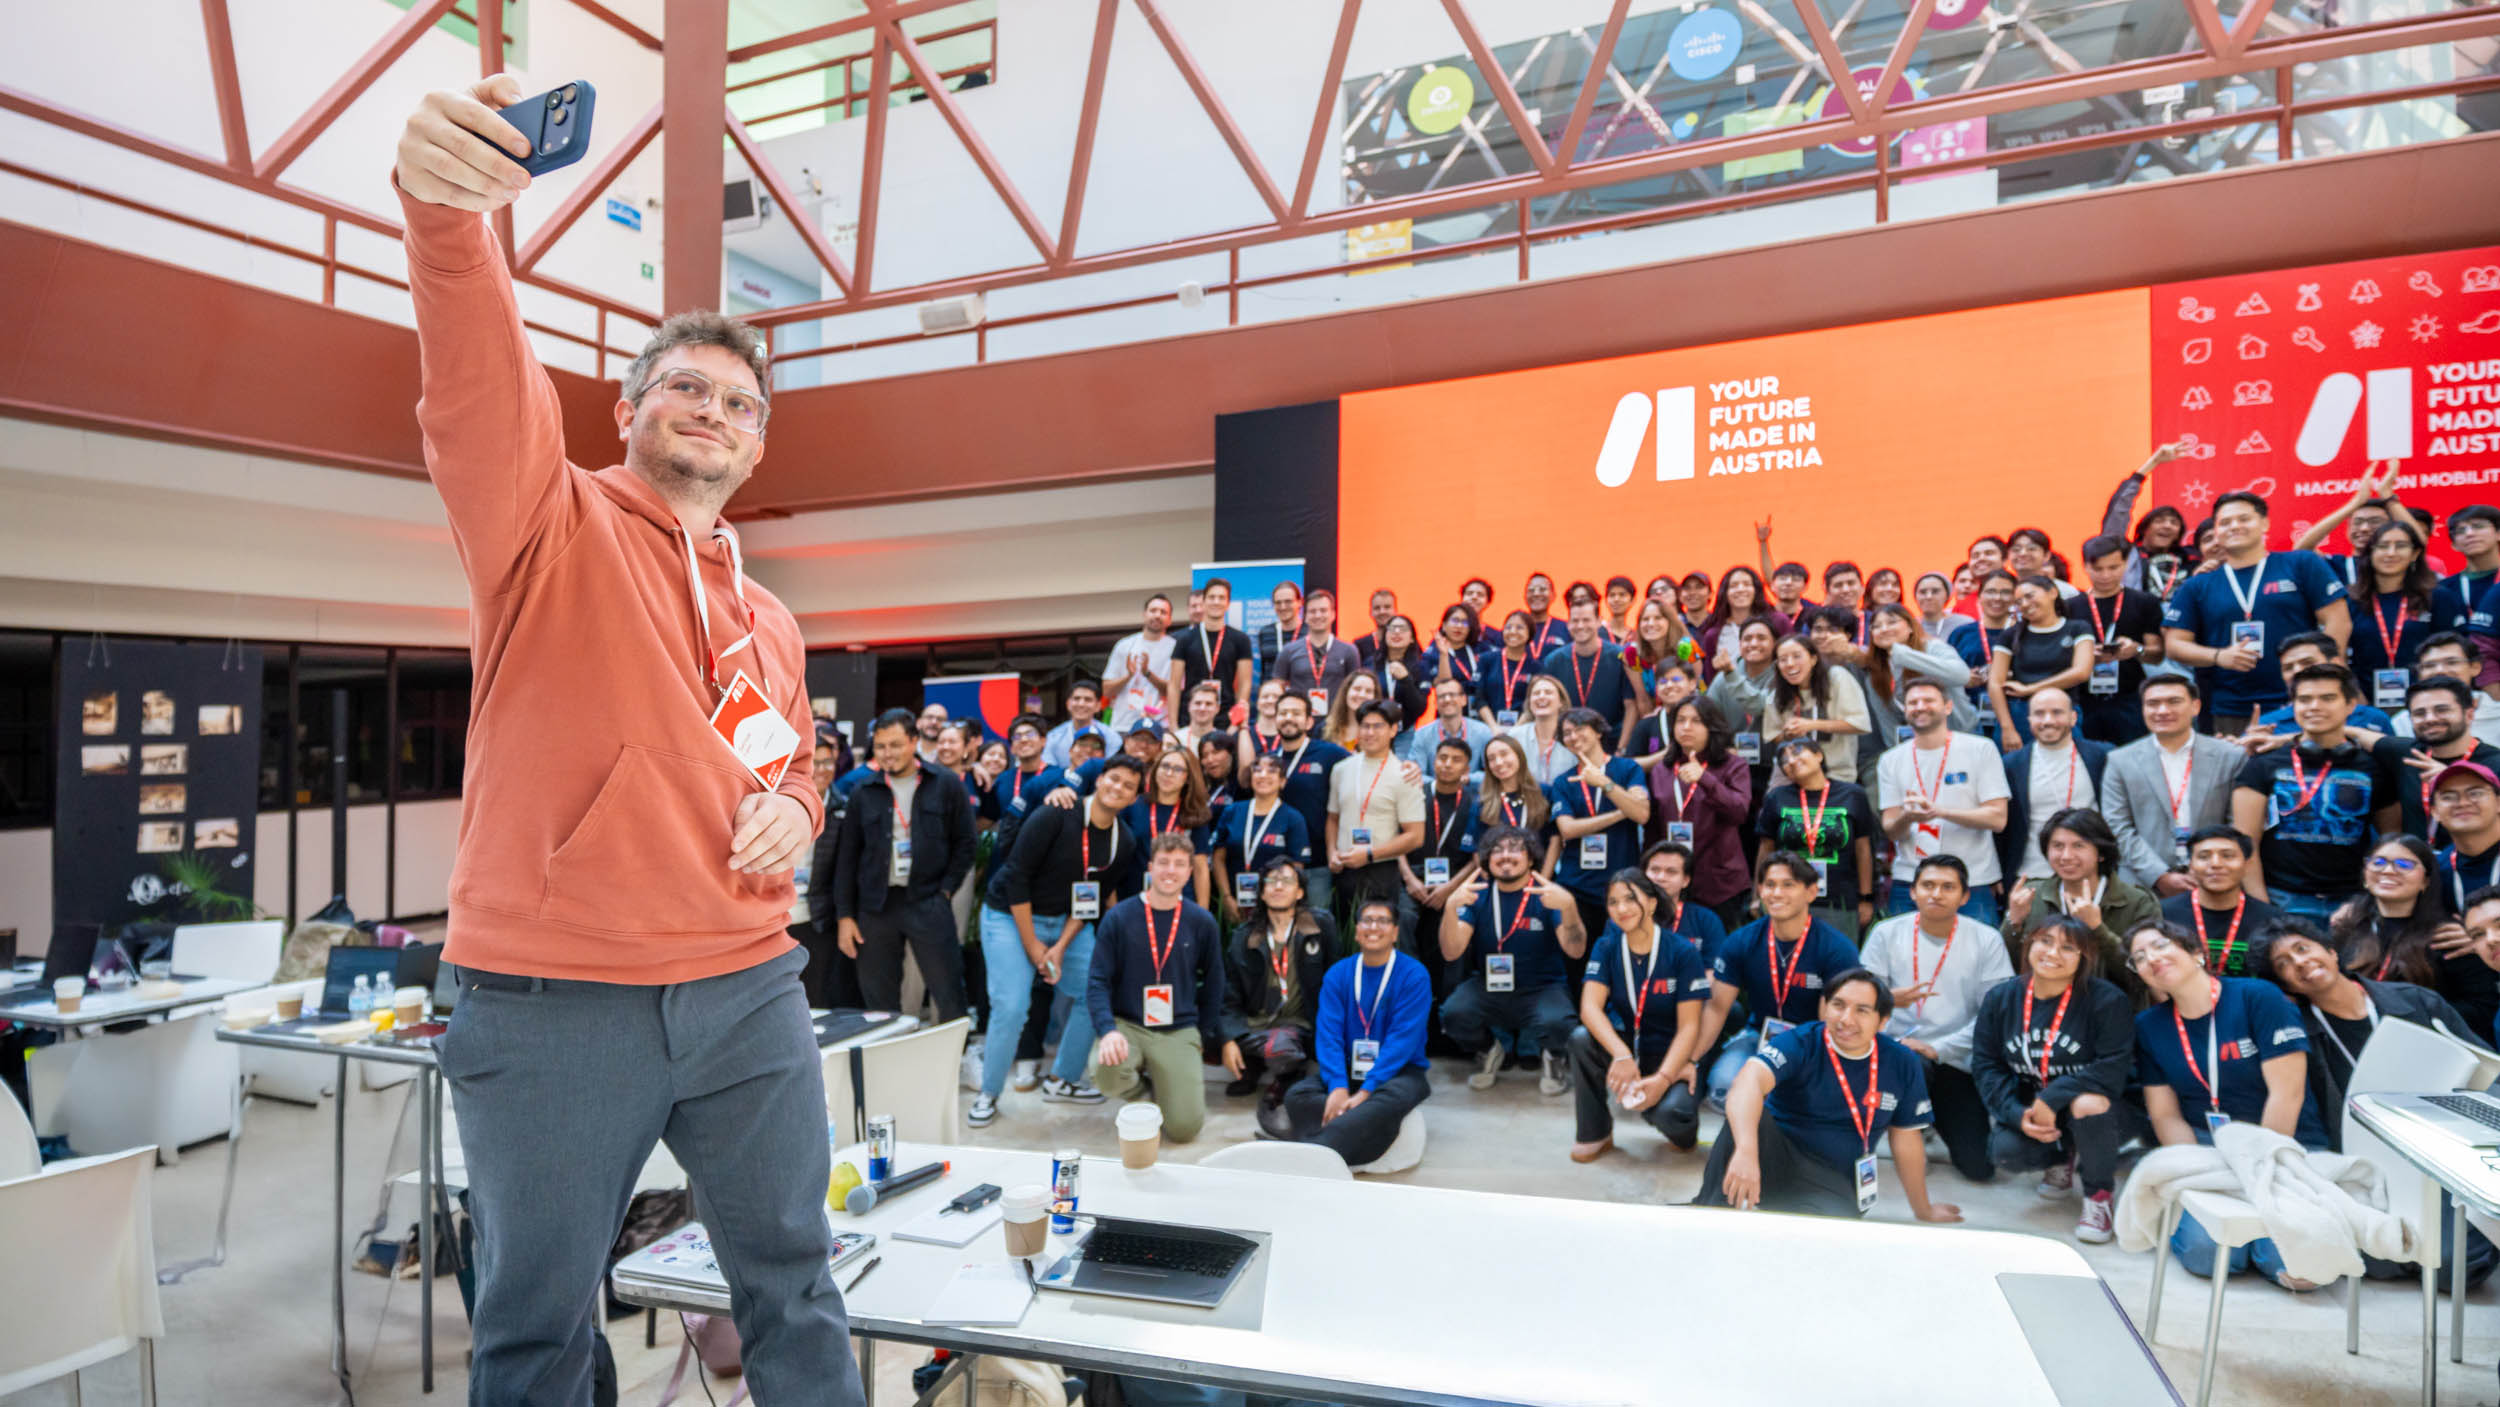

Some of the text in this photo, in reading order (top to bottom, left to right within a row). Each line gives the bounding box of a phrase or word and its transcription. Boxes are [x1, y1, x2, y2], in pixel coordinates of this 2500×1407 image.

[2427, 358, 2500, 384] YOUR
[1709, 376, 1779, 402] YOUR
[1709, 396, 1811, 427] FUTURE
[1709, 421, 1816, 452] MADE IN
[1708, 446, 1823, 477] AUSTRIA
